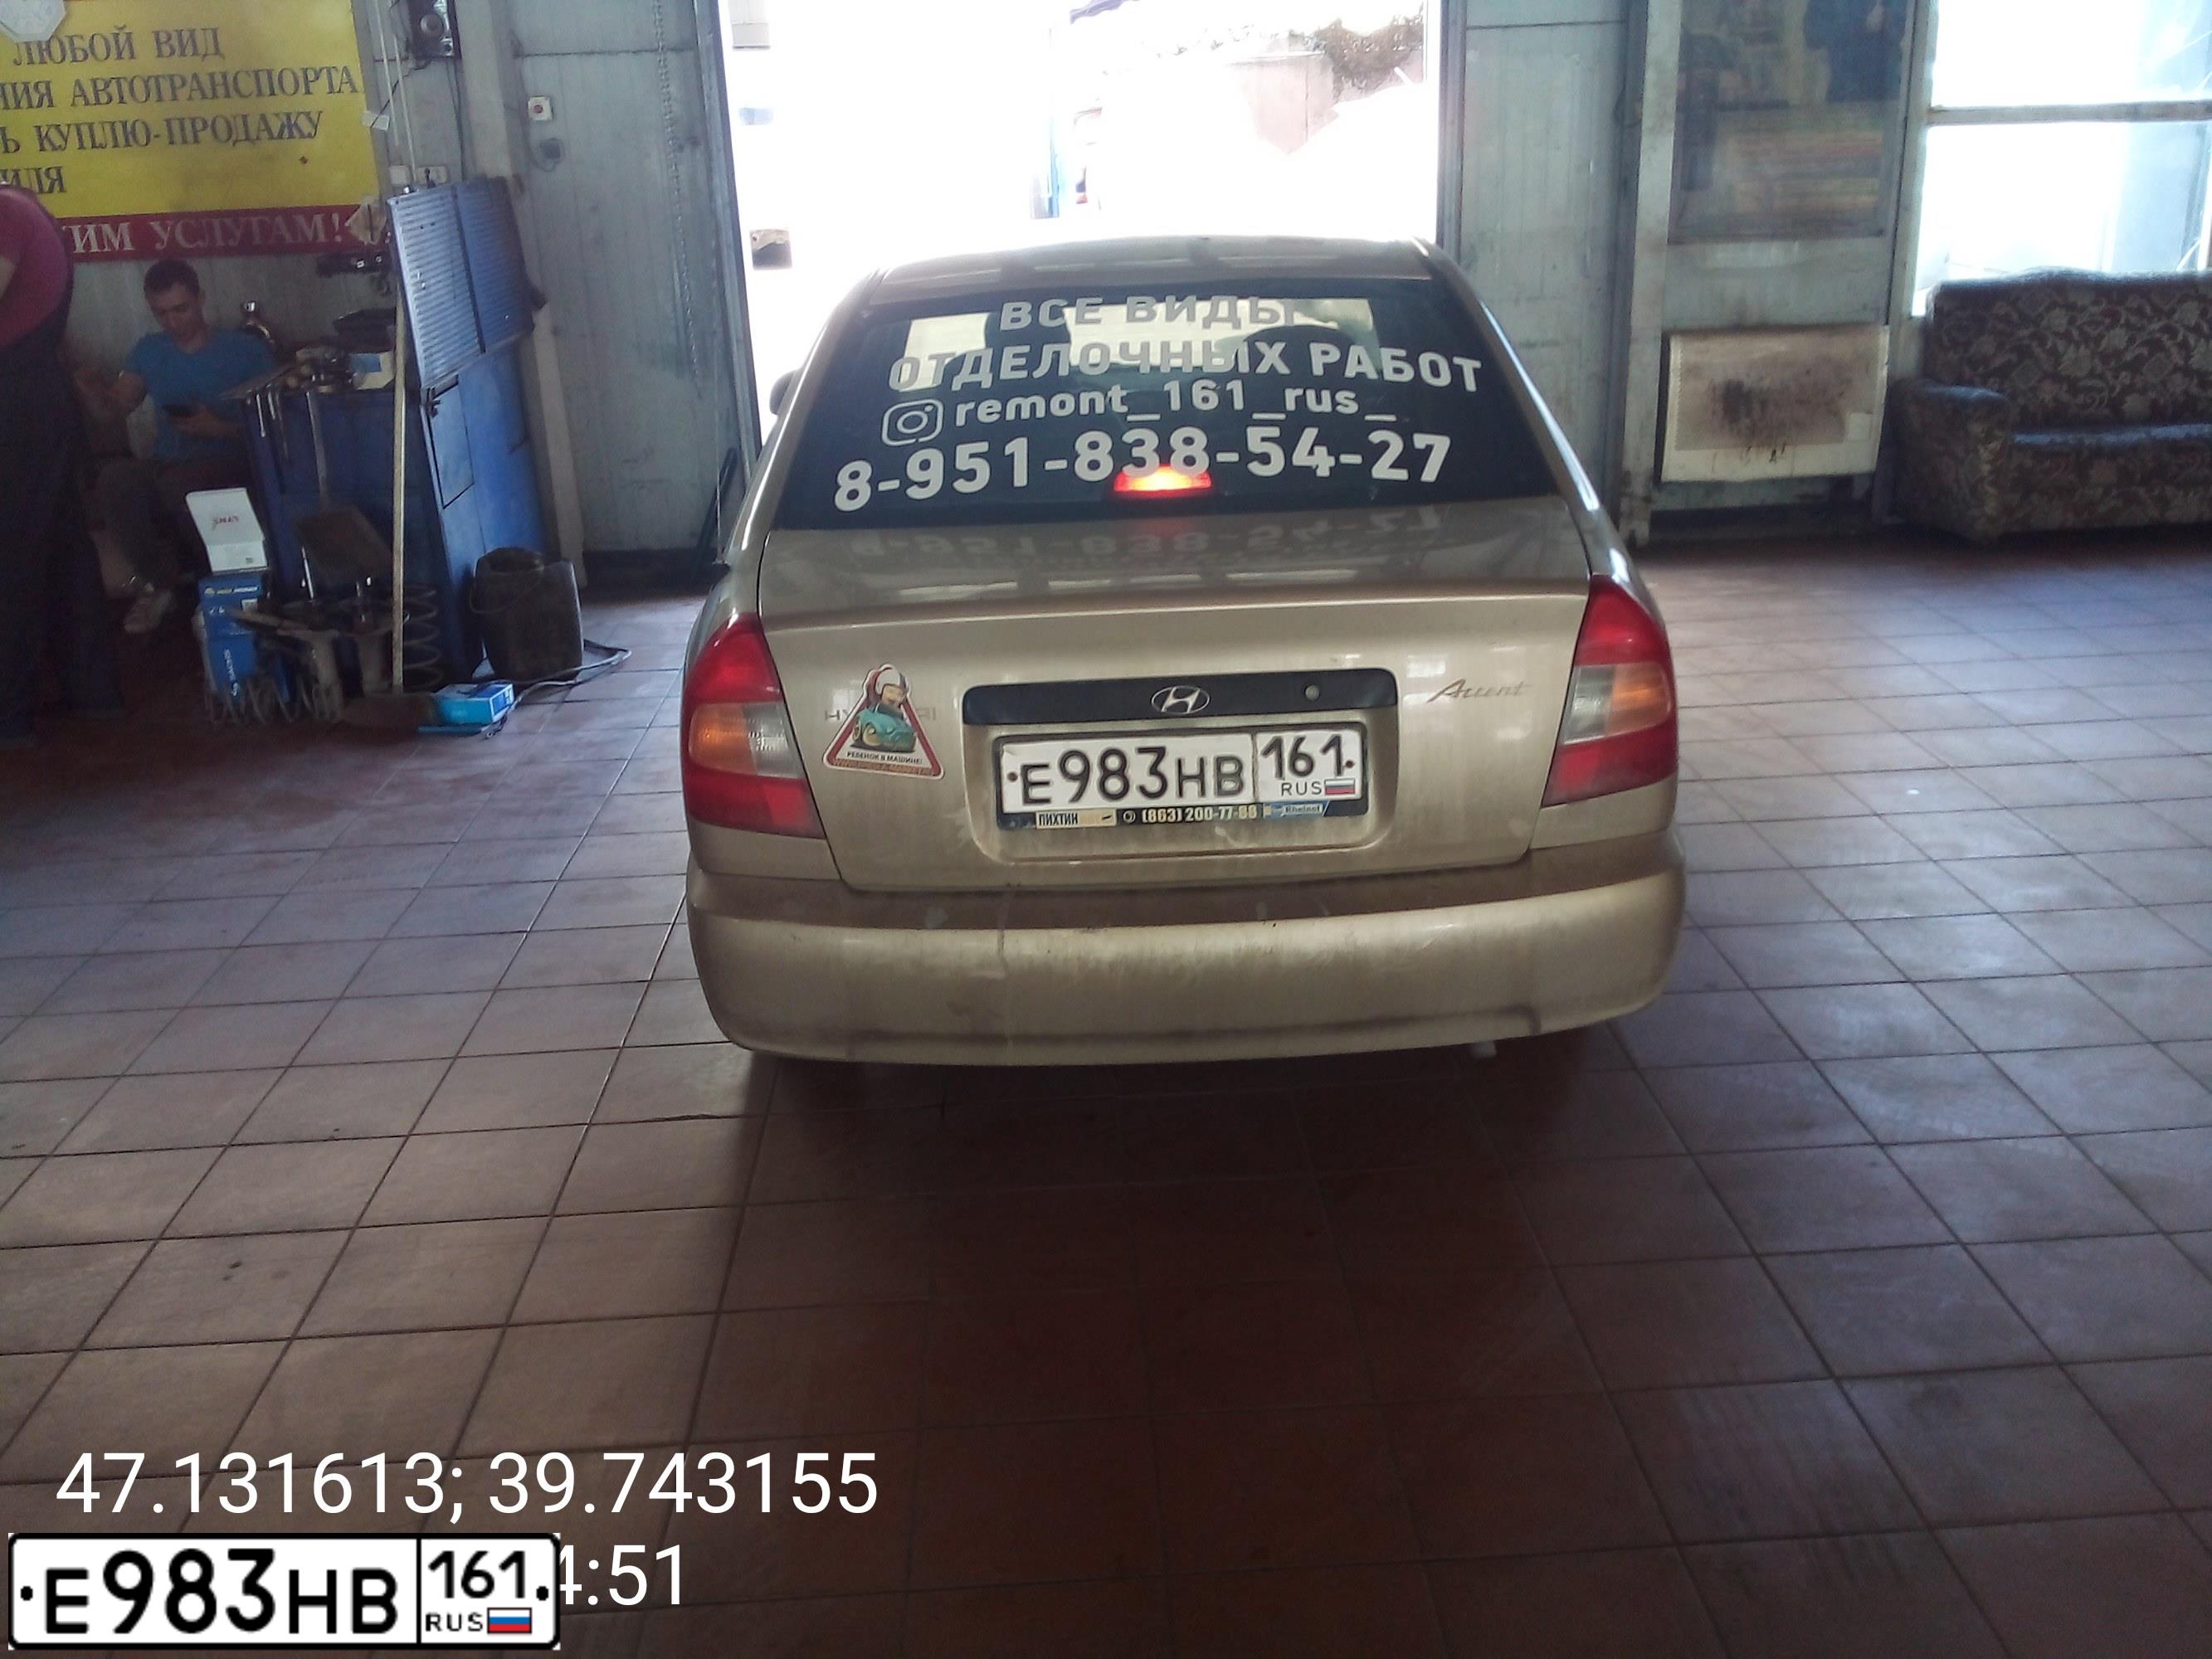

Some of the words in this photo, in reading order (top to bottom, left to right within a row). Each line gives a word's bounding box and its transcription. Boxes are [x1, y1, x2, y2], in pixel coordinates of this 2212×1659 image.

[13, 25, 135, 66] ЛЮБОЙ
[152, 27, 225, 61] ВИД
[71, 66, 358, 107] АВТОТРАНСПОРТА
[34, 112, 322, 153] КУПЛЮ-ПРОДАЖУ
[149, 213, 342, 249] УСЛУГАМ!
[1000, 295, 1104, 331] ВСЕ
[1125, 294, 1294, 330] ВИДЫ
[889, 340, 1291, 391] ОТДЕЛОЧНЫХ
[1310, 341, 1483, 392] РАБОТ
[835, 426, 1451, 512] 8-951-838-54-27
[1426, 679, 1532, 703] Accent
[1021, 747, 1245, 805] Е983НВ
[1261, 736, 1347, 778] 161
[1281, 780, 1323, 796] RUS
[1039, 812, 1078, 826] ПИХТИН
